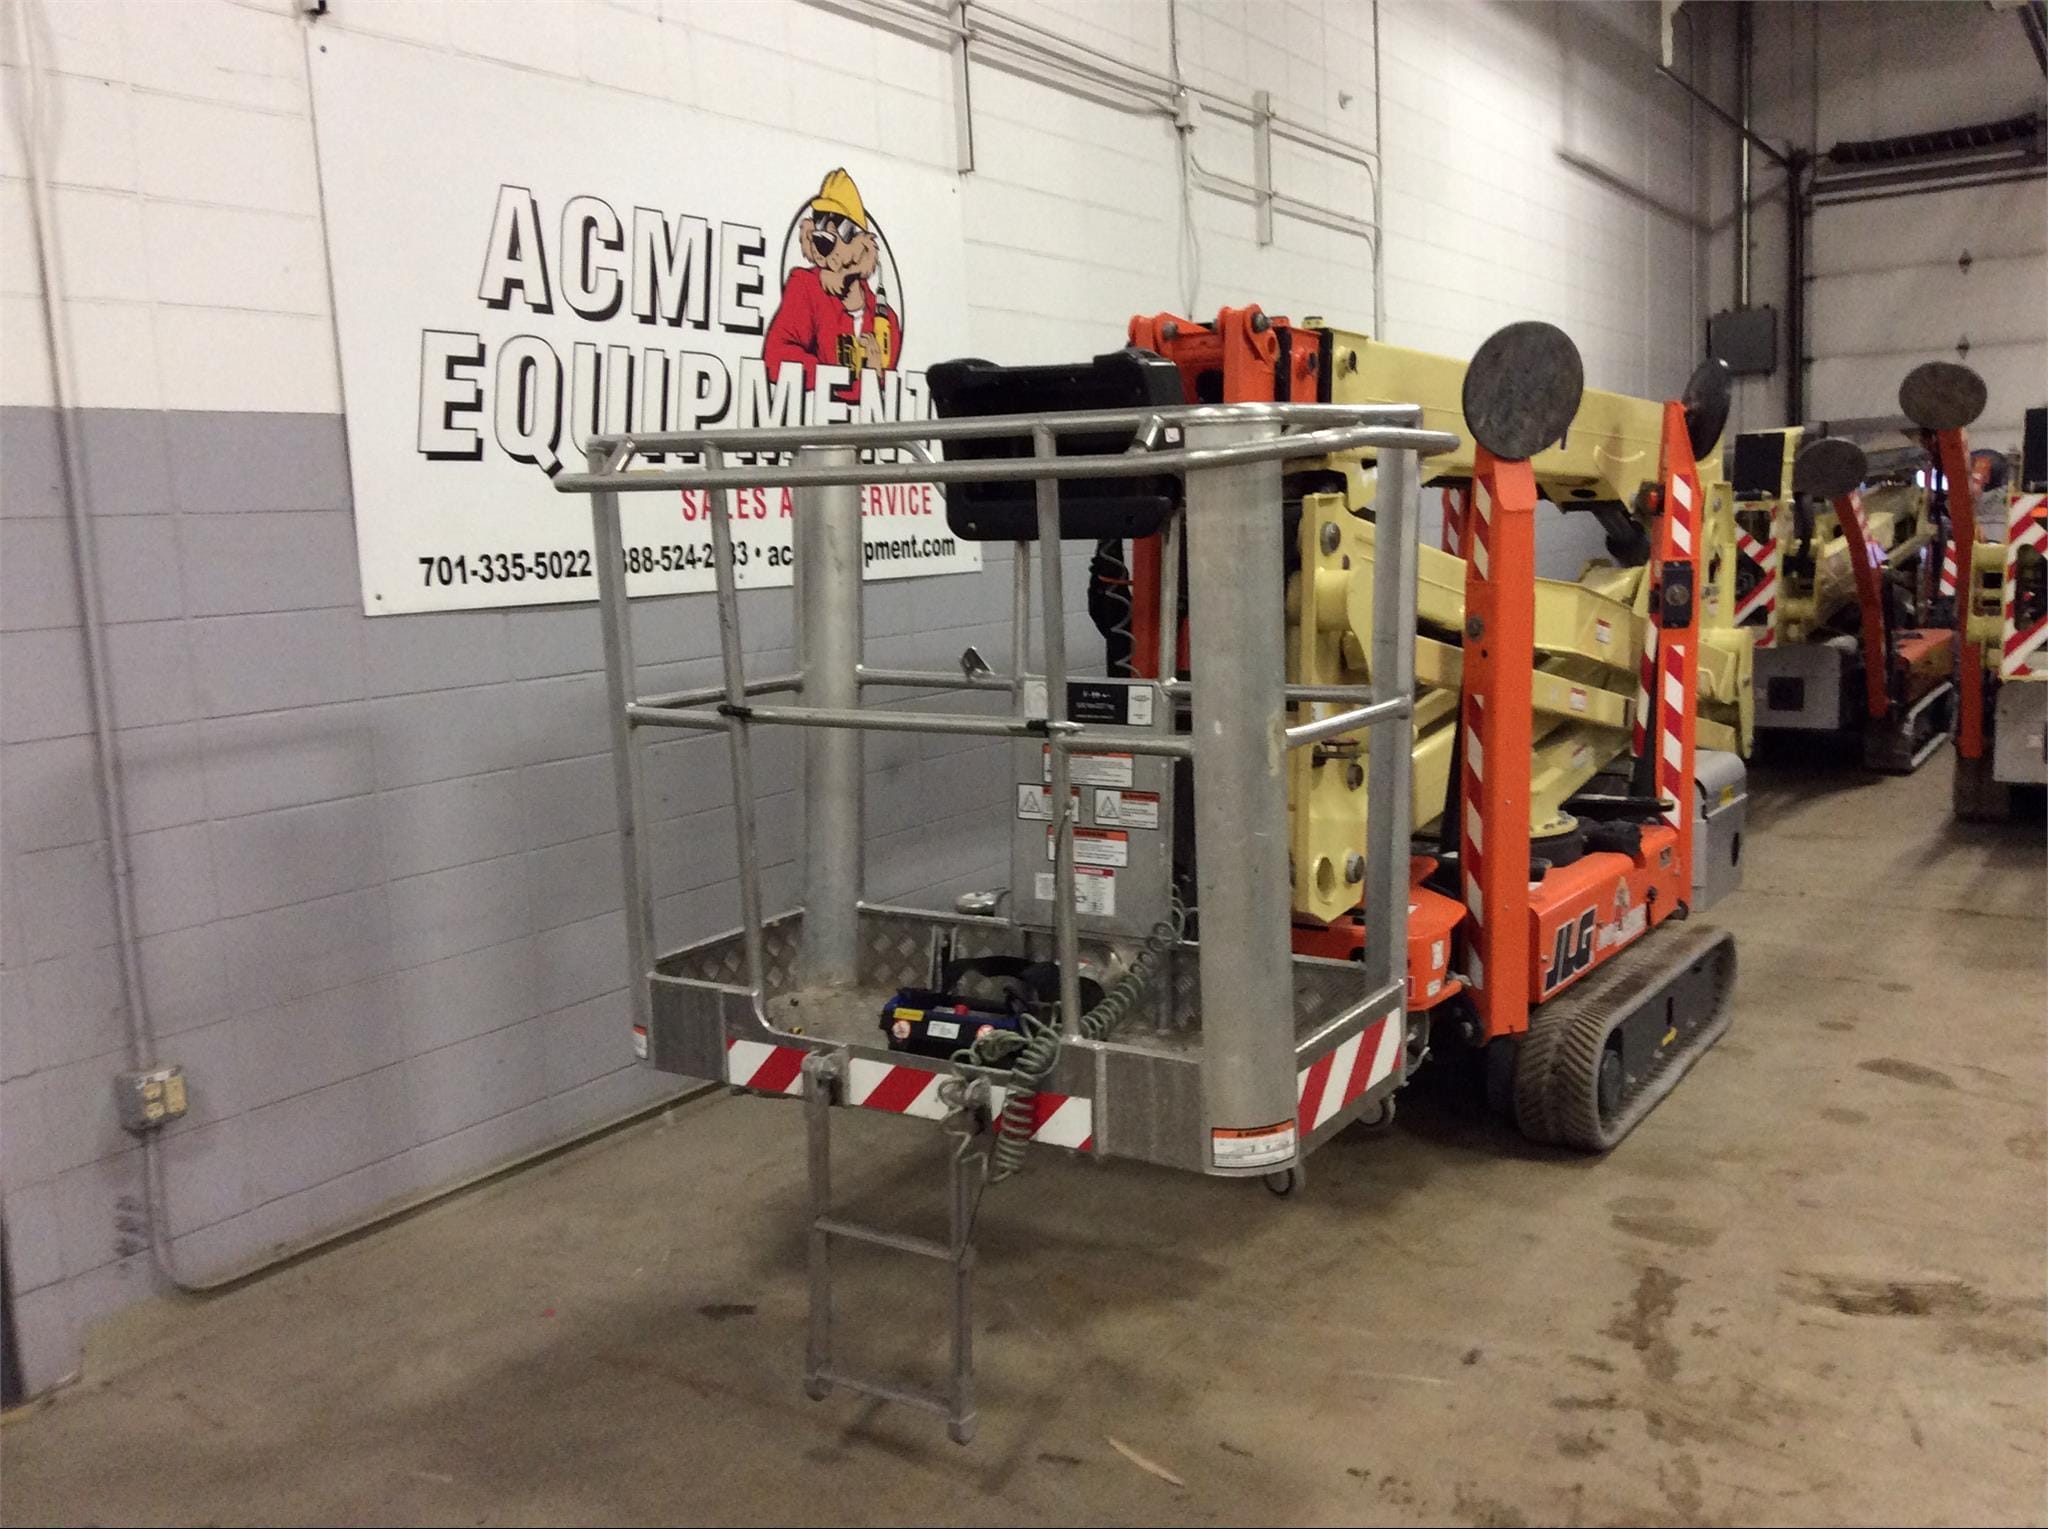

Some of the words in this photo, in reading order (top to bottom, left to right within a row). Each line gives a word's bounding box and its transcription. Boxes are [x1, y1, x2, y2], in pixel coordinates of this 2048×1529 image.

[478, 183, 767, 334] ACME
[417, 328, 937, 477] EQUIPMENT
[682, 485, 767, 521] SAES
[860, 485, 933, 517] ERVICE
[418, 550, 592, 587] 701-335-5022
[1543, 905, 1597, 995] JLG
